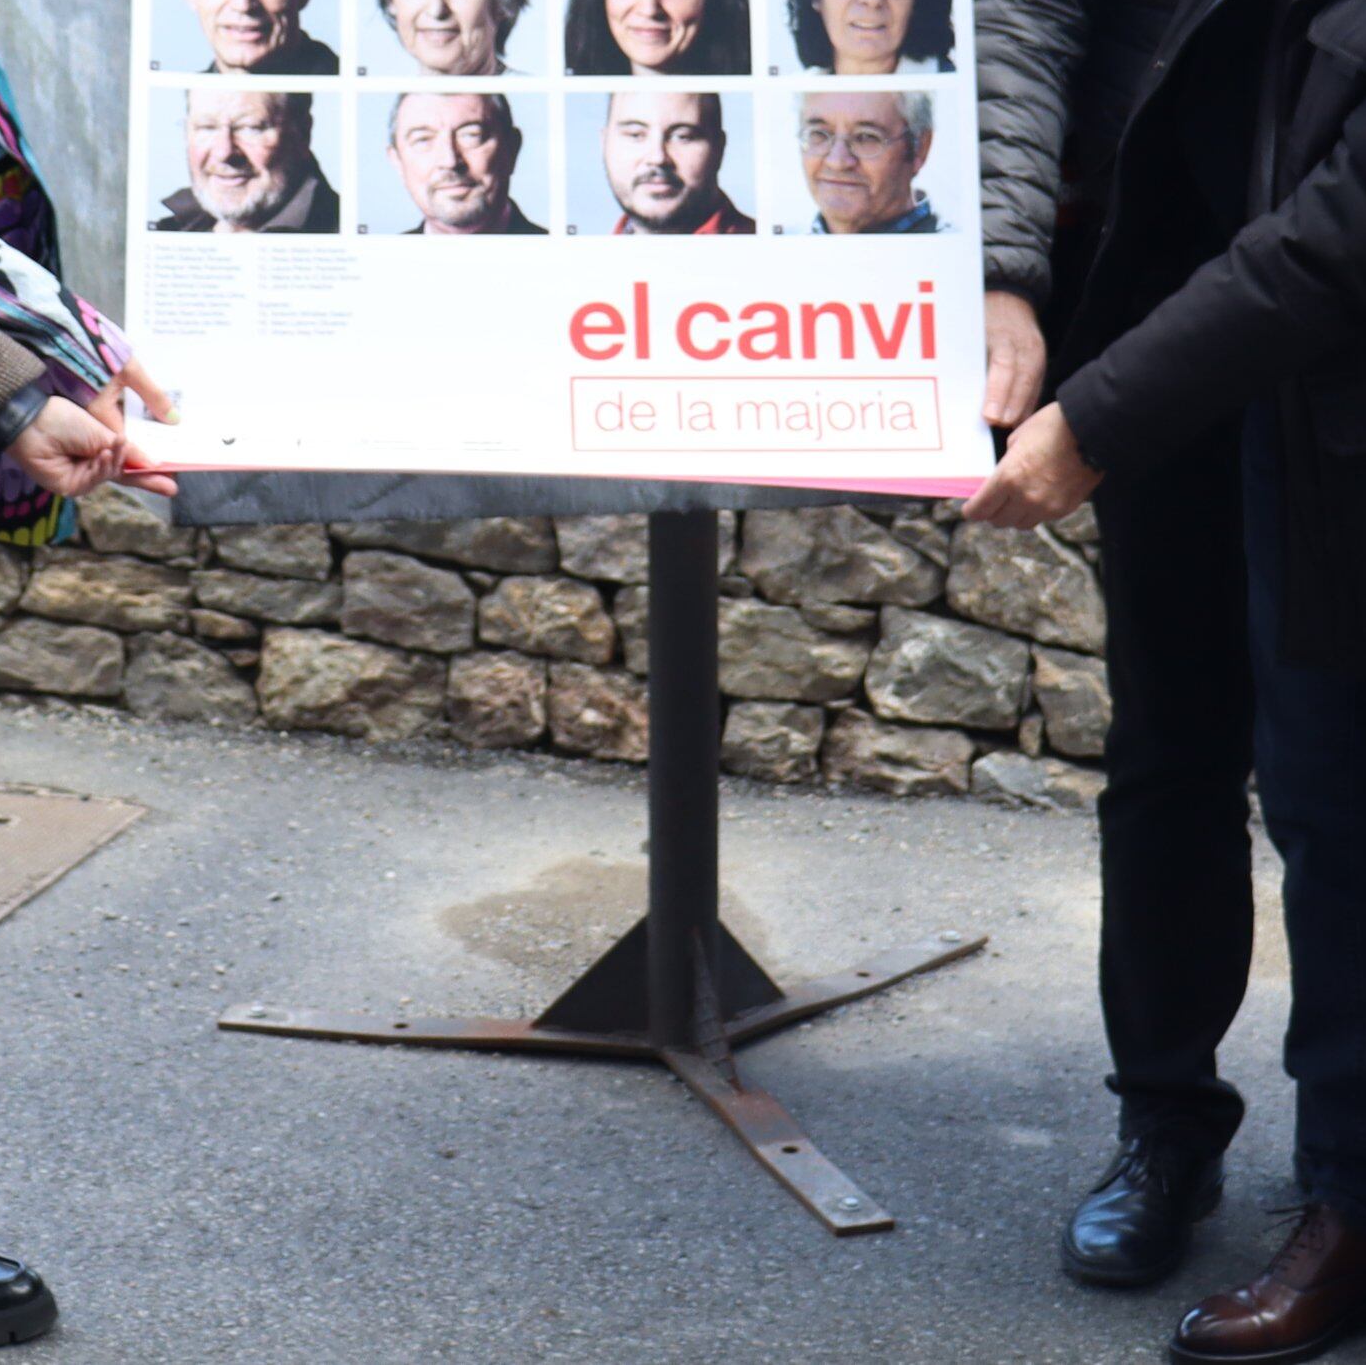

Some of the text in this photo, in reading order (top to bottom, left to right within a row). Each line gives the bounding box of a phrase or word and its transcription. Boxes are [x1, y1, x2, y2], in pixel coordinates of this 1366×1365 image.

[569, 280, 937, 361] el canvi
[595, 391, 919, 441] de la majoria
